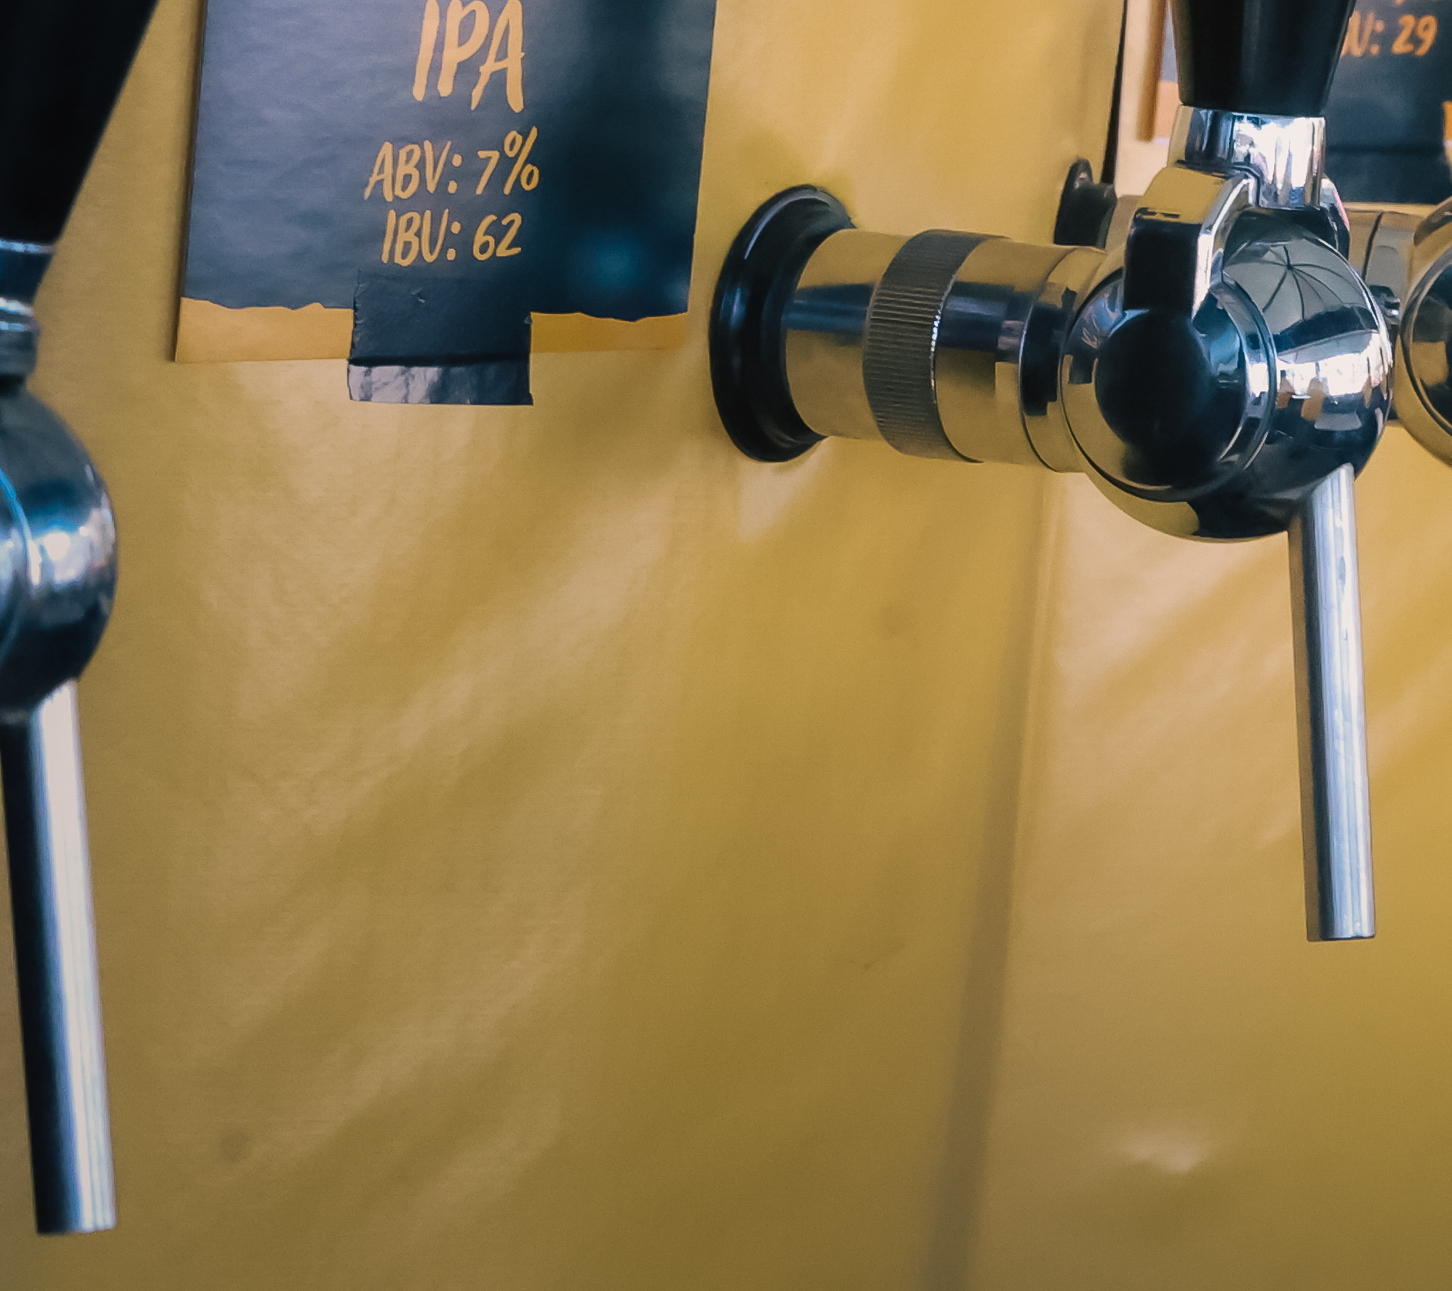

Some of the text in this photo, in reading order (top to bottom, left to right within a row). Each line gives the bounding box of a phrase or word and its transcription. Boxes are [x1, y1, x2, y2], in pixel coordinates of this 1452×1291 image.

[1392, 14, 1438, 57] 29
[364, 126, 540, 201] ABV: 7%
[381, 209, 522, 267] IBU: 62
